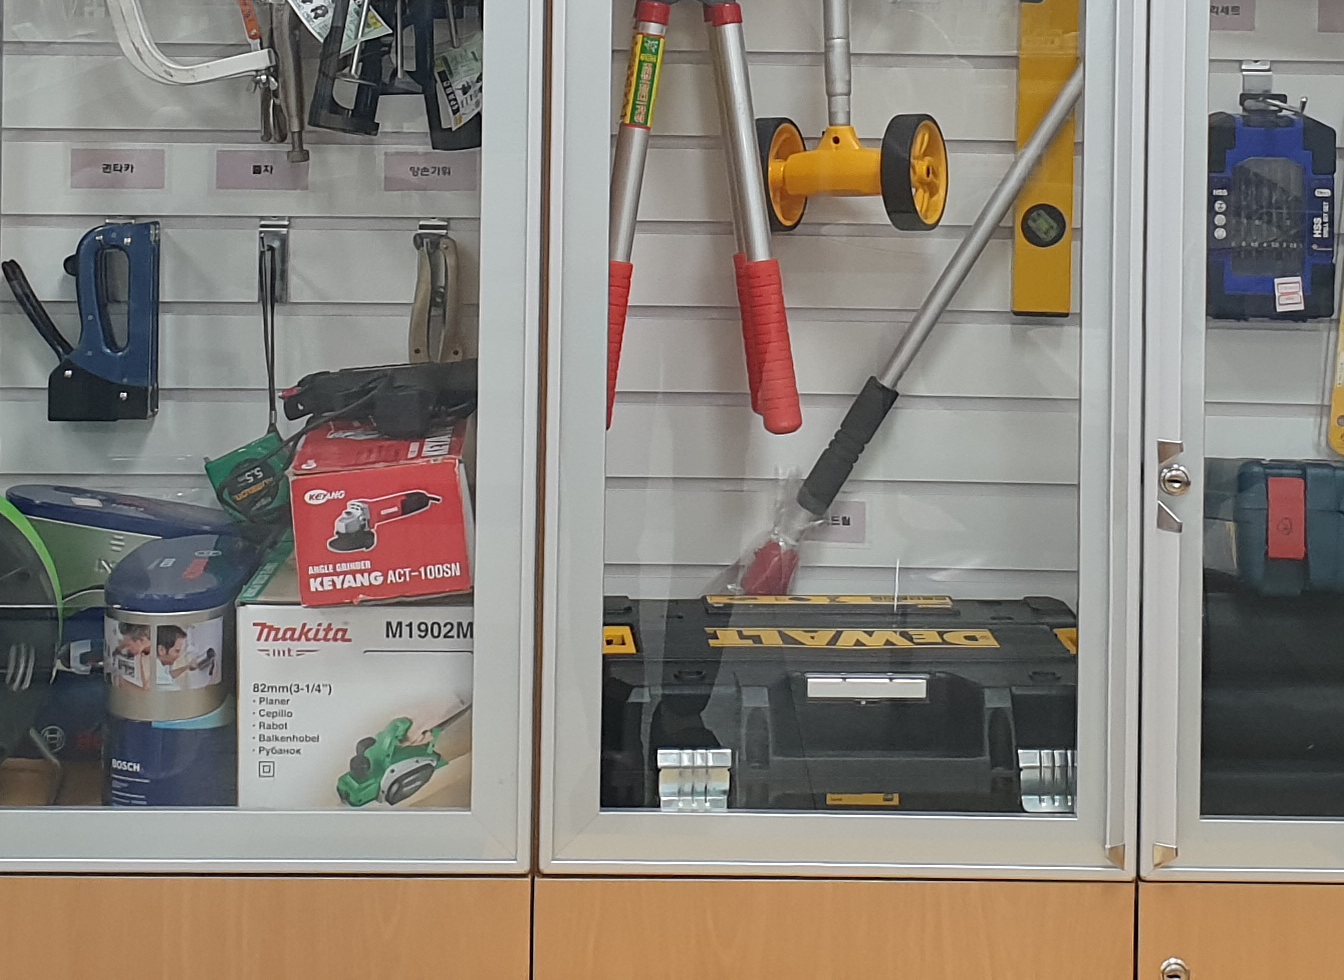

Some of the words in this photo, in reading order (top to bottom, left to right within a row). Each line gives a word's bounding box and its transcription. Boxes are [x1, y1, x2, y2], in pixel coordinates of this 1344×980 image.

[307, 490, 345, 502] KEYANG
[309, 565, 333, 574] ANGLE
[336, 561, 371, 572] GRINDER
[310, 571, 384, 592] KEYANG
[253, 622, 352, 643] makita
[385, 621, 474, 639] M1902M
[705, 628, 1000, 648] DEWALT
[259, 697, 290, 706] Planer
[259, 709, 293, 719] Cepillo
[259, 721, 288, 730] Rabot
[259, 734, 320, 743] Balkenhobel
[259, 746, 301, 755] Рубанок
[112, 758, 141, 772] BOSCH
